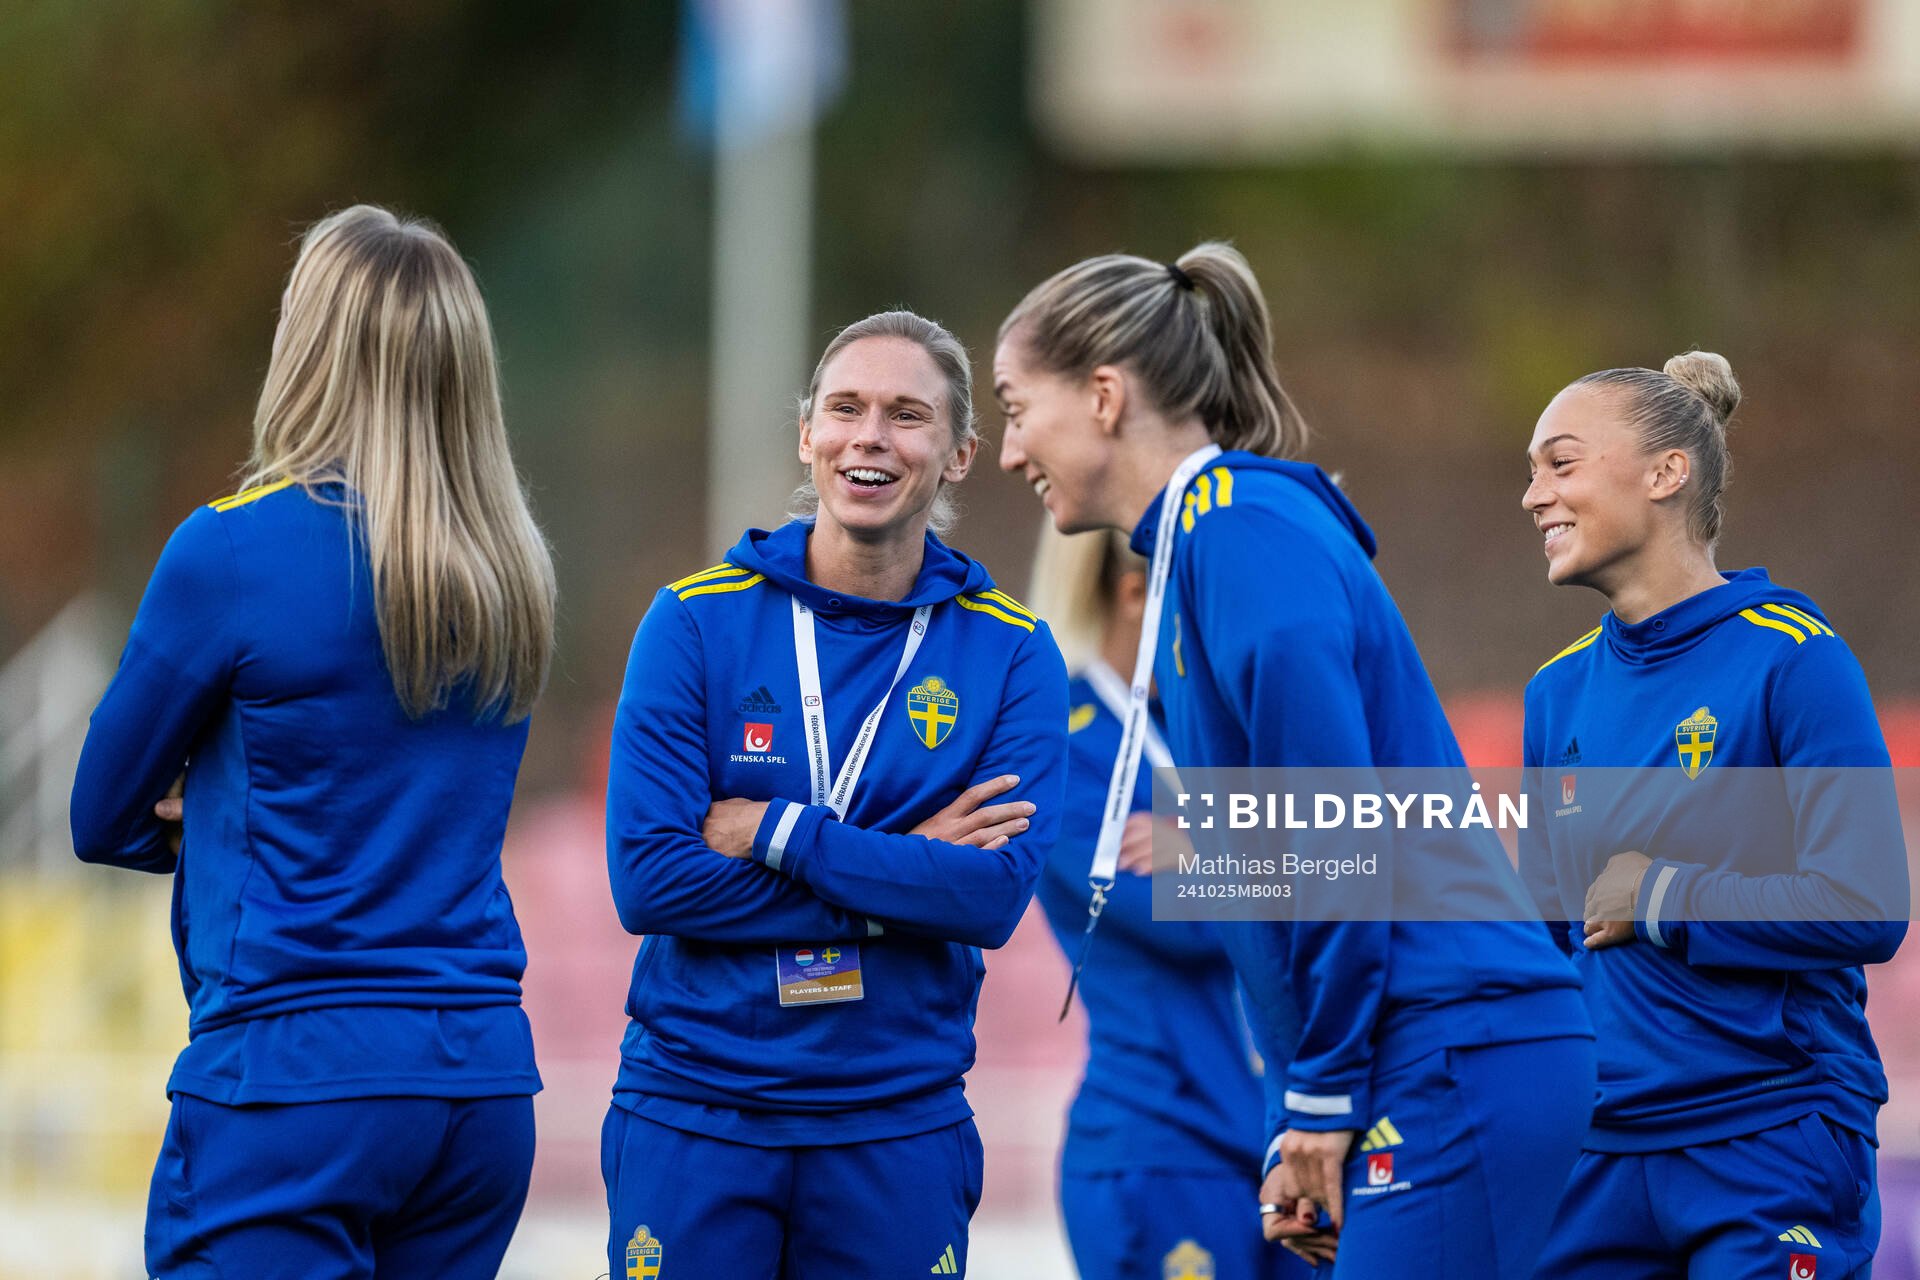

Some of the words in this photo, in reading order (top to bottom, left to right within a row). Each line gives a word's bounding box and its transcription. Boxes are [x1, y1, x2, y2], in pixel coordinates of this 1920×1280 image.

[916, 695, 951, 705] SVERIGE
[738, 703, 782, 713] adidas
[1682, 724, 1710, 733] SVERIGE
[730, 754, 765, 763] SVENSKA
[766, 755, 787, 764] SPEL
[790, 986, 822, 995] PLAYERS
[830, 984, 853, 993] STAFF
[629, 1248, 655, 1256] SVERIGE
